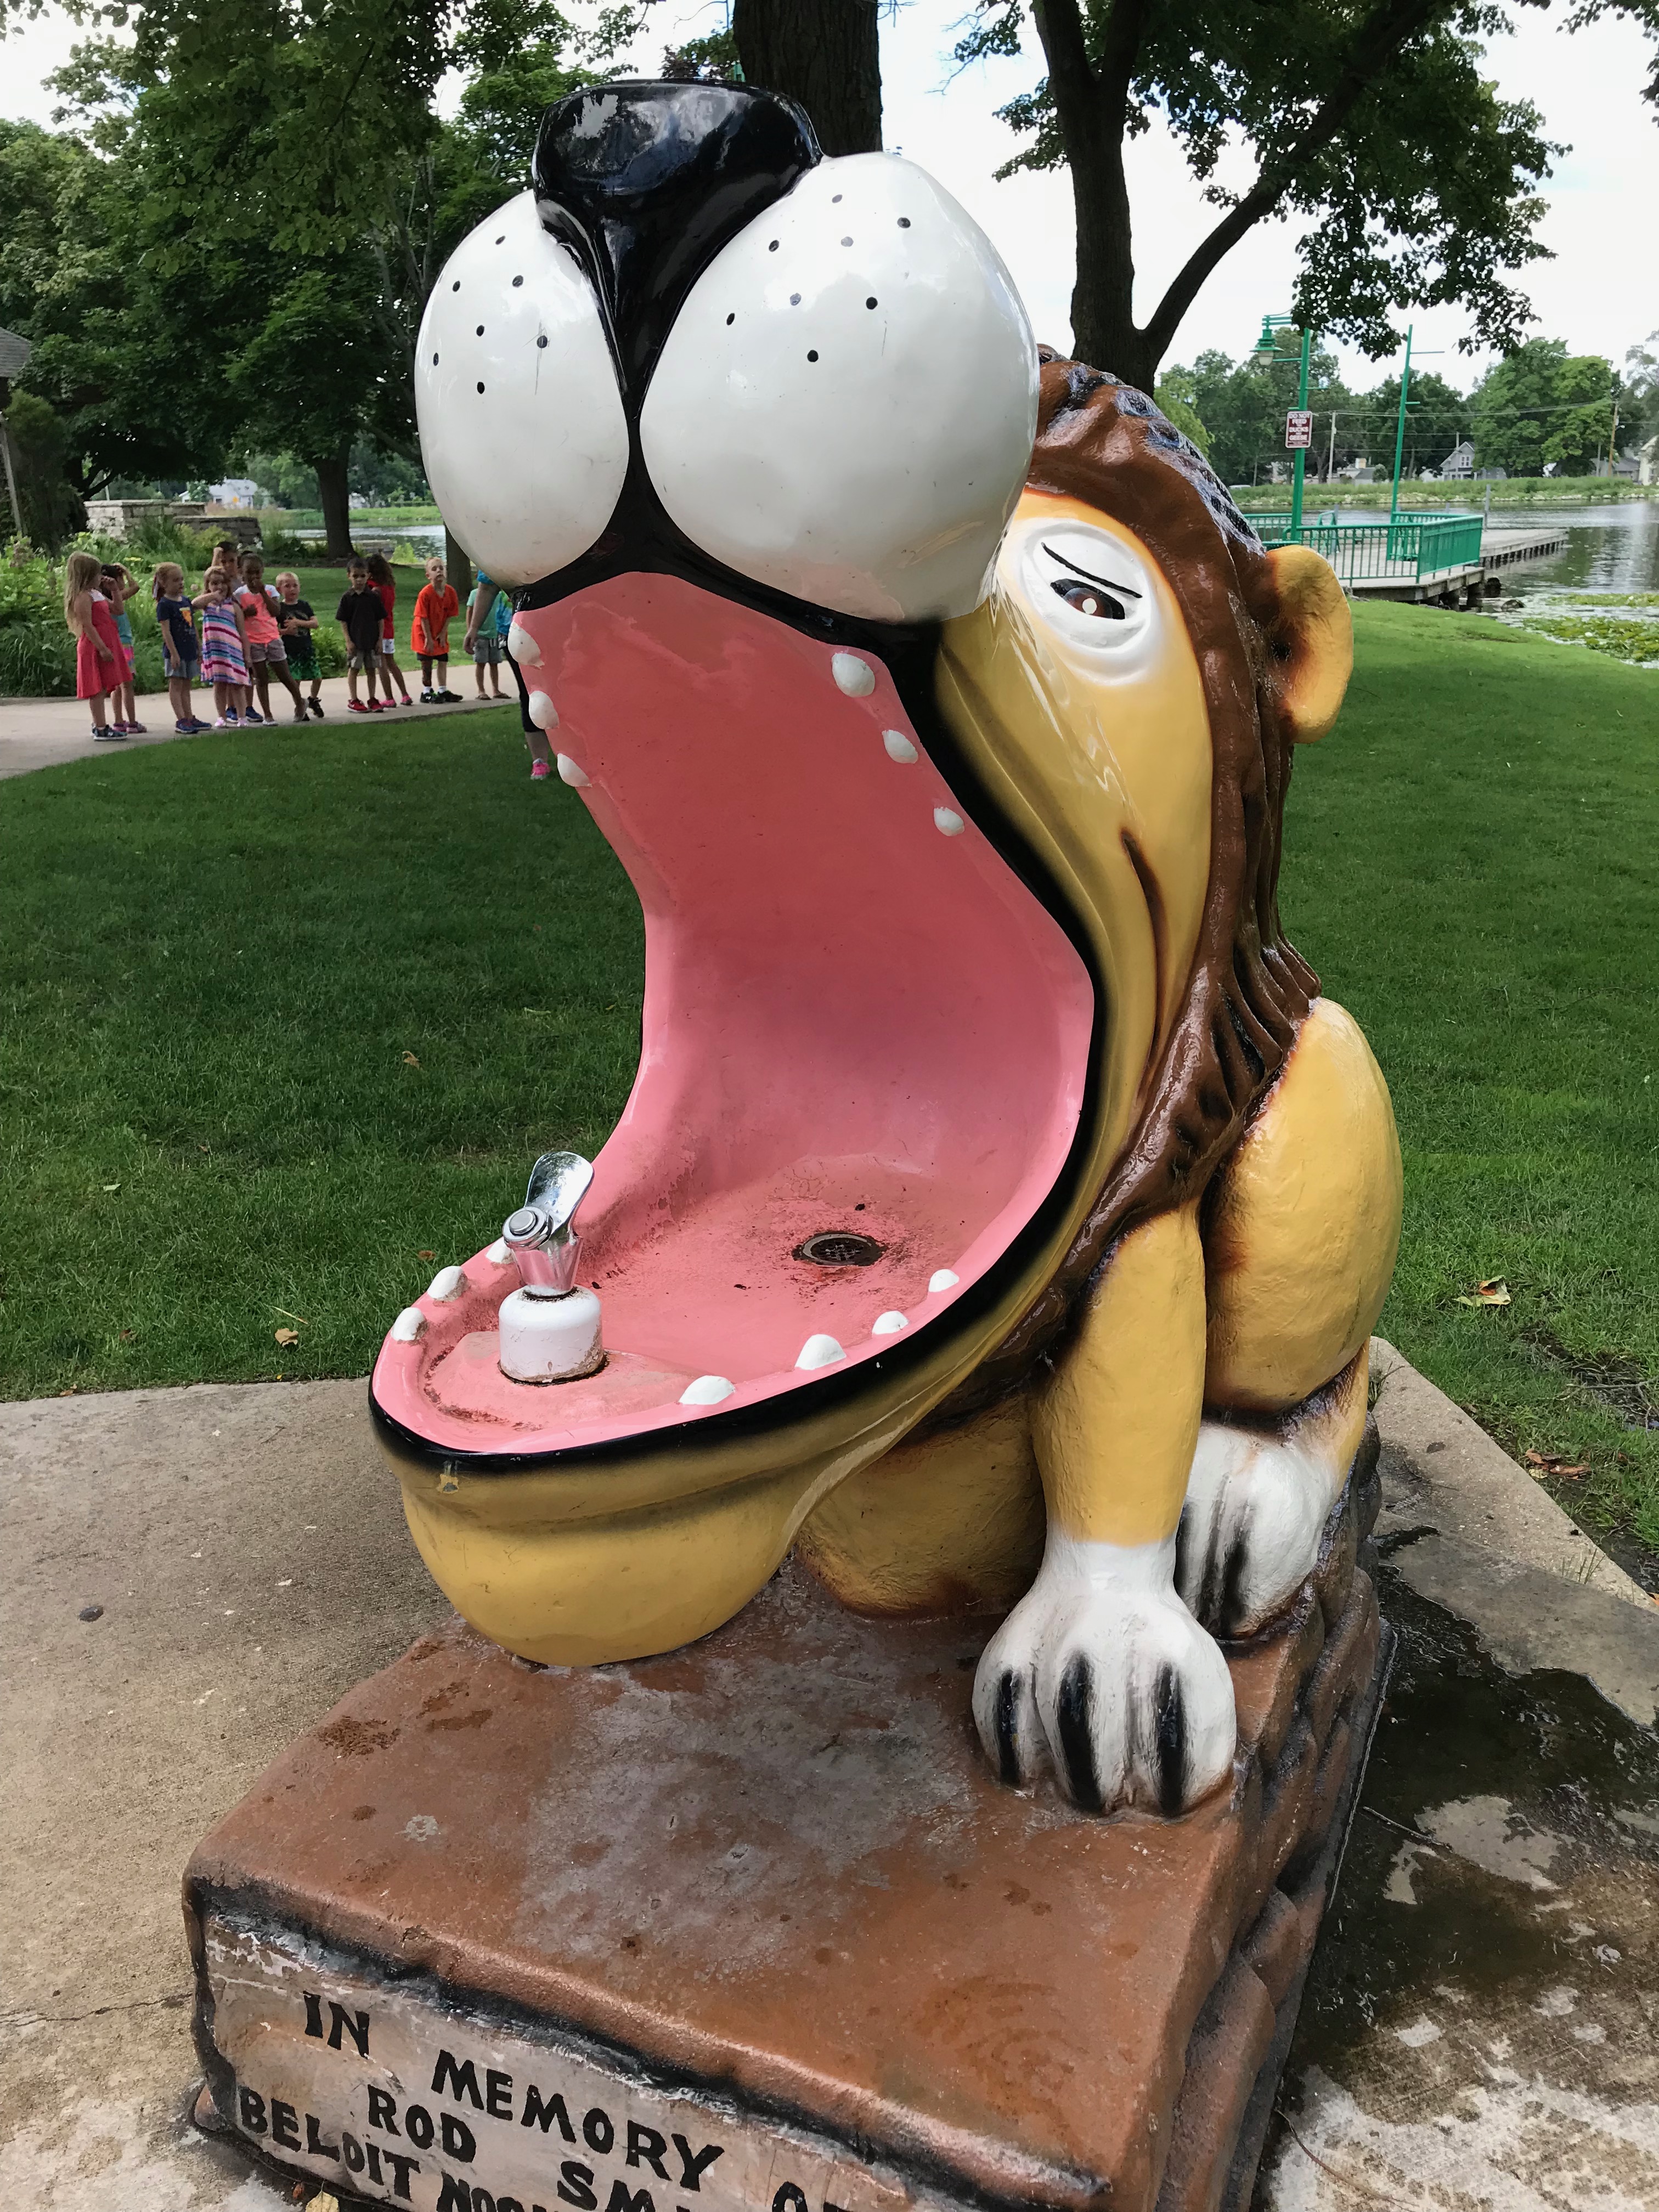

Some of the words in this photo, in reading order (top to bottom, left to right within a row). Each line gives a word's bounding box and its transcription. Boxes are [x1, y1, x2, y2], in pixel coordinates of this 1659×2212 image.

[240, 2086, 421, 2202] BELOIT
[303, 1990, 370, 2058] IN
[431, 2049, 725, 2192] MEMORY
[771, 2181, 855, 2212] O
[368, 2084, 477, 2163] ROD
